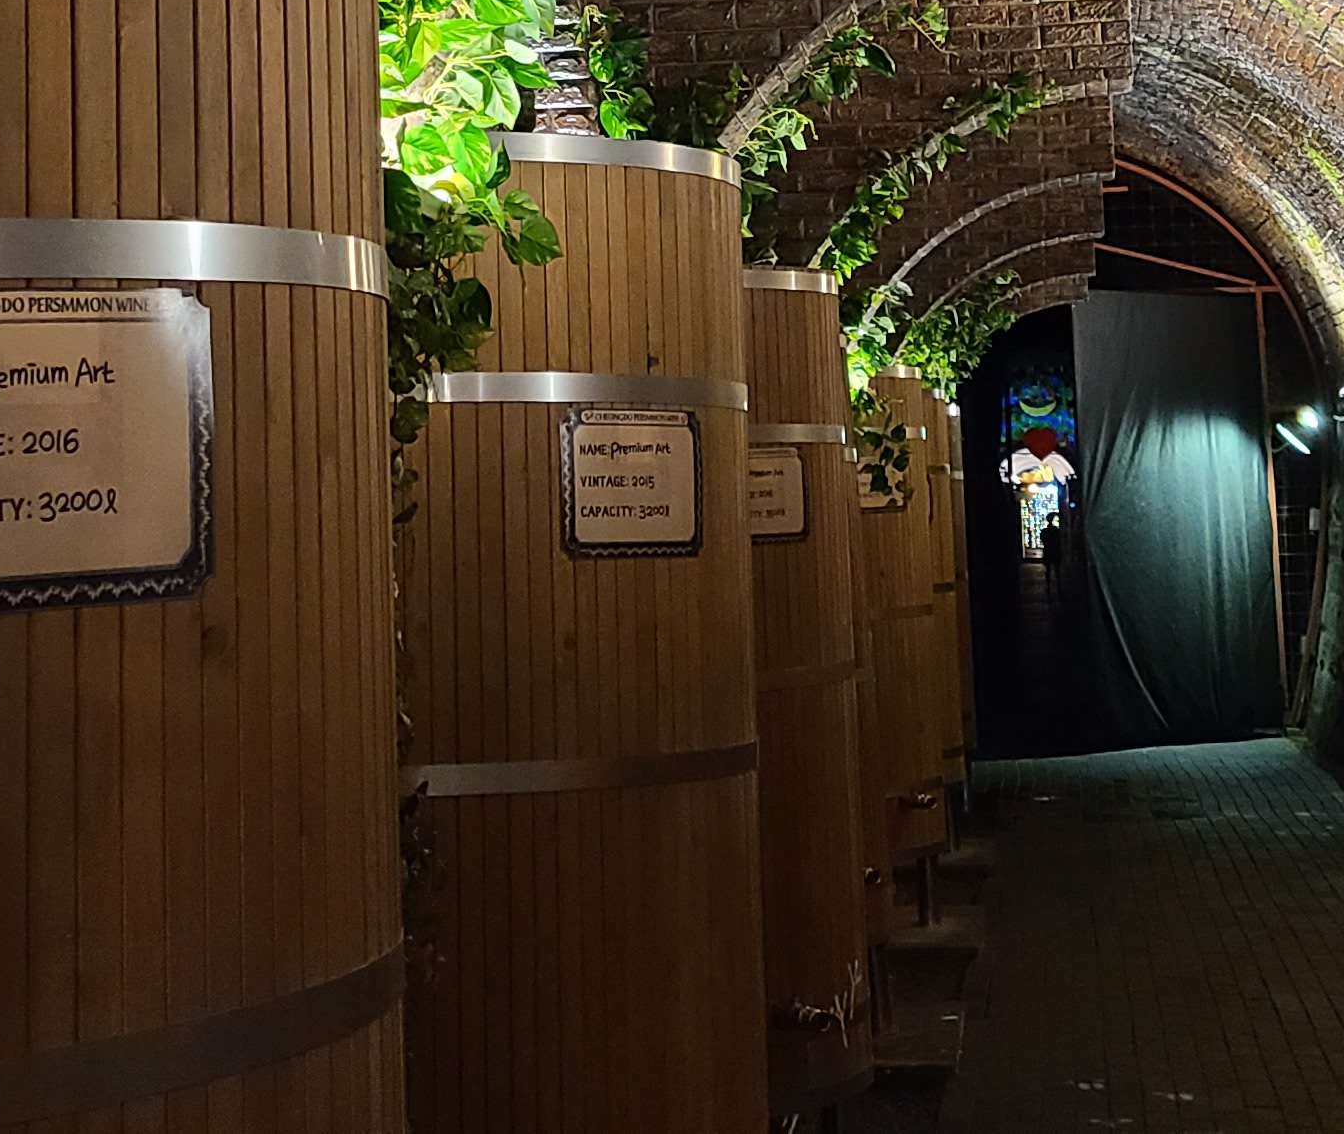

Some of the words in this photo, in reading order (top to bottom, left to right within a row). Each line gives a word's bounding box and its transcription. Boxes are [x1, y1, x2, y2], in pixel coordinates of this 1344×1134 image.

[28, 297, 113, 313] PERSMMON
[115, 296, 150, 312] WINE
[75, 357, 116, 387] Art
[22, 428, 80, 454] 2016
[580, 443, 610, 455] NAME:
[611, 442, 654, 460] Premium
[655, 442, 671, 454] Art
[580, 475, 629, 487] VINTAGE:
[631, 475, 655, 489] 2015
[580, 506, 636, 517] CAPACITY:
